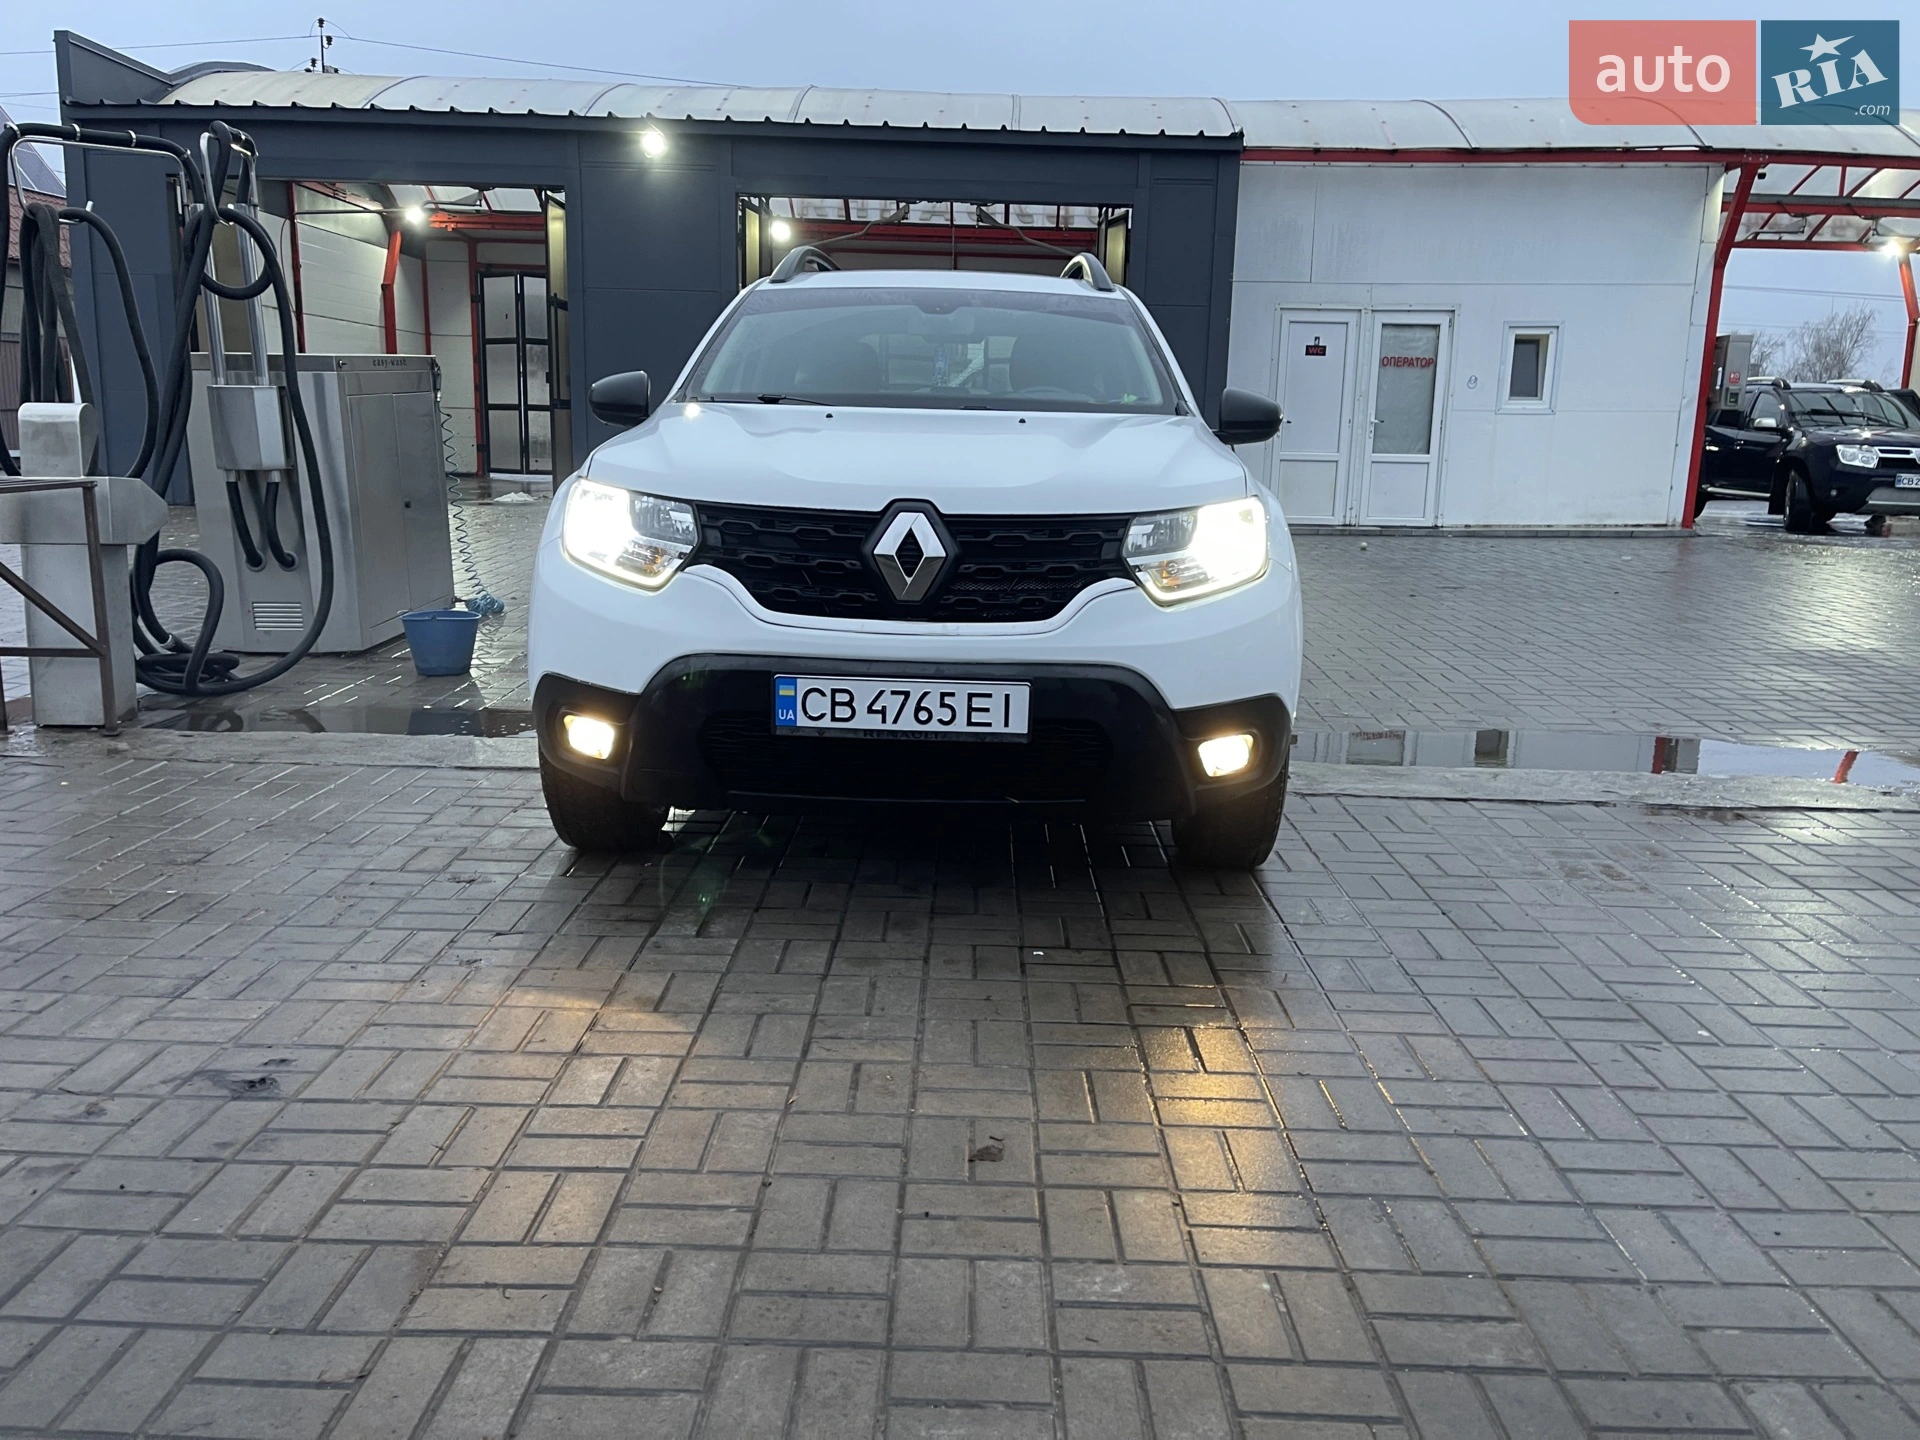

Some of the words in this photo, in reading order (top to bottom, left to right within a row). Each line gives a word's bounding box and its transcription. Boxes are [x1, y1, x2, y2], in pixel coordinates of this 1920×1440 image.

[1308, 346, 1325, 355] WC
[1381, 356, 1435, 368] ОПЕРАТОР
[778, 709, 795, 721] UA
